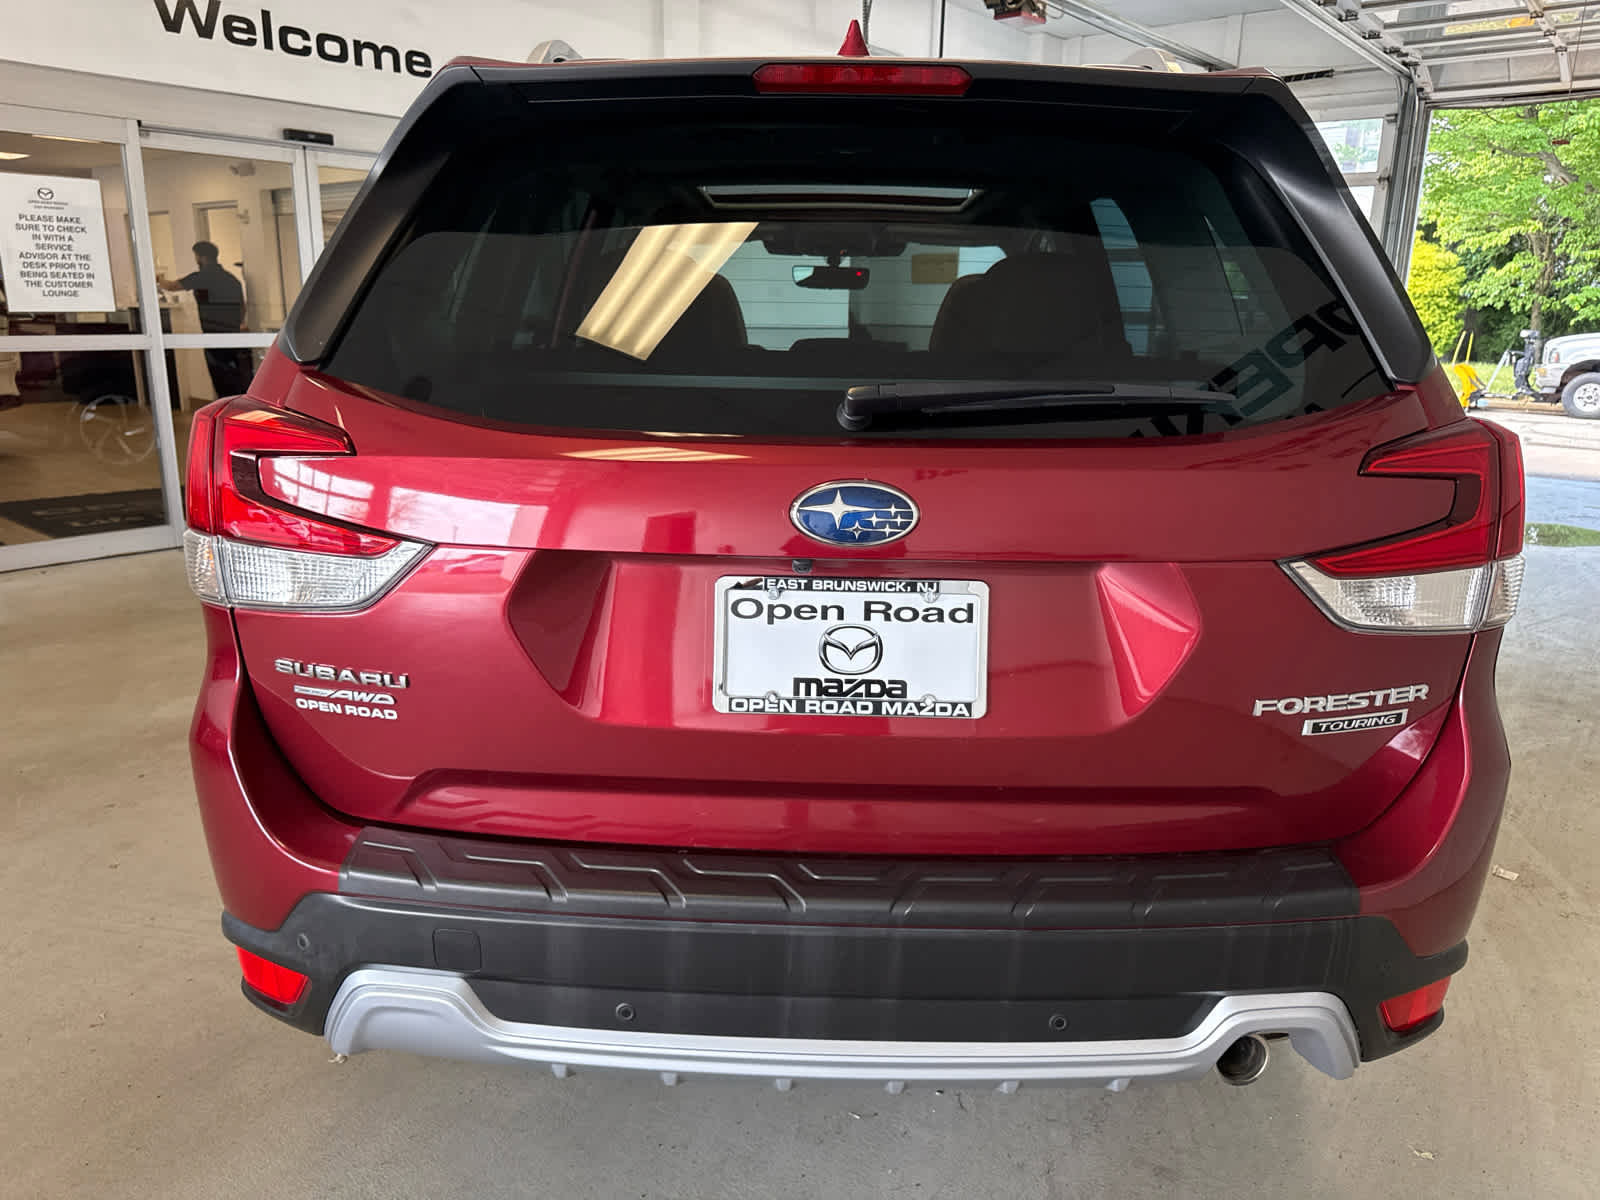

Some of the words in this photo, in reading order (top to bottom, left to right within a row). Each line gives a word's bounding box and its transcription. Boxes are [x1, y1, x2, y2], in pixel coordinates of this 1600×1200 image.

[153, 0, 433, 78] Welcome
[18, 213, 54, 223] PLEASE
[56, 215, 82, 224] MAKE
[15, 223, 40, 231] SURE
[42, 224, 55, 232] TO
[56, 225, 87, 234] CHECK
[32, 233, 41, 241] IN
[43, 234, 65, 242] WITH
[35, 243, 73, 251] SERVICE
[19, 252, 58, 260] ADVISOR
[61, 253, 72, 261] AT
[22, 261, 48, 269] DESK
[49, 262, 76, 270] PRIOR
[78, 263, 90, 271] TO
[20, 271, 48, 279] BEING
[50, 271, 85, 279] SEATED
[86, 272, 95, 280] IN
[24, 280, 42, 288] THE
[44, 280, 93, 288] CUSTOMER
[766, 578, 808, 591] EAST
[812, 579, 911, 592] BRUNSWICK,
[916, 581, 938, 593] NJ
[730, 597, 845, 625] Open
[863, 600, 974, 624] Road
[274, 657, 410, 689] SUBARU
[329, 688, 397, 705] AWD
[1252, 684, 1430, 717] FORESTER
[296, 697, 342, 714] OPEN
[344, 704, 398, 720] ROAD
[731, 698, 797, 713] OPEN
[805, 700, 874, 715] ROAD
[881, 701, 970, 717] MAZDA
[1318, 714, 1398, 732] TOURING
